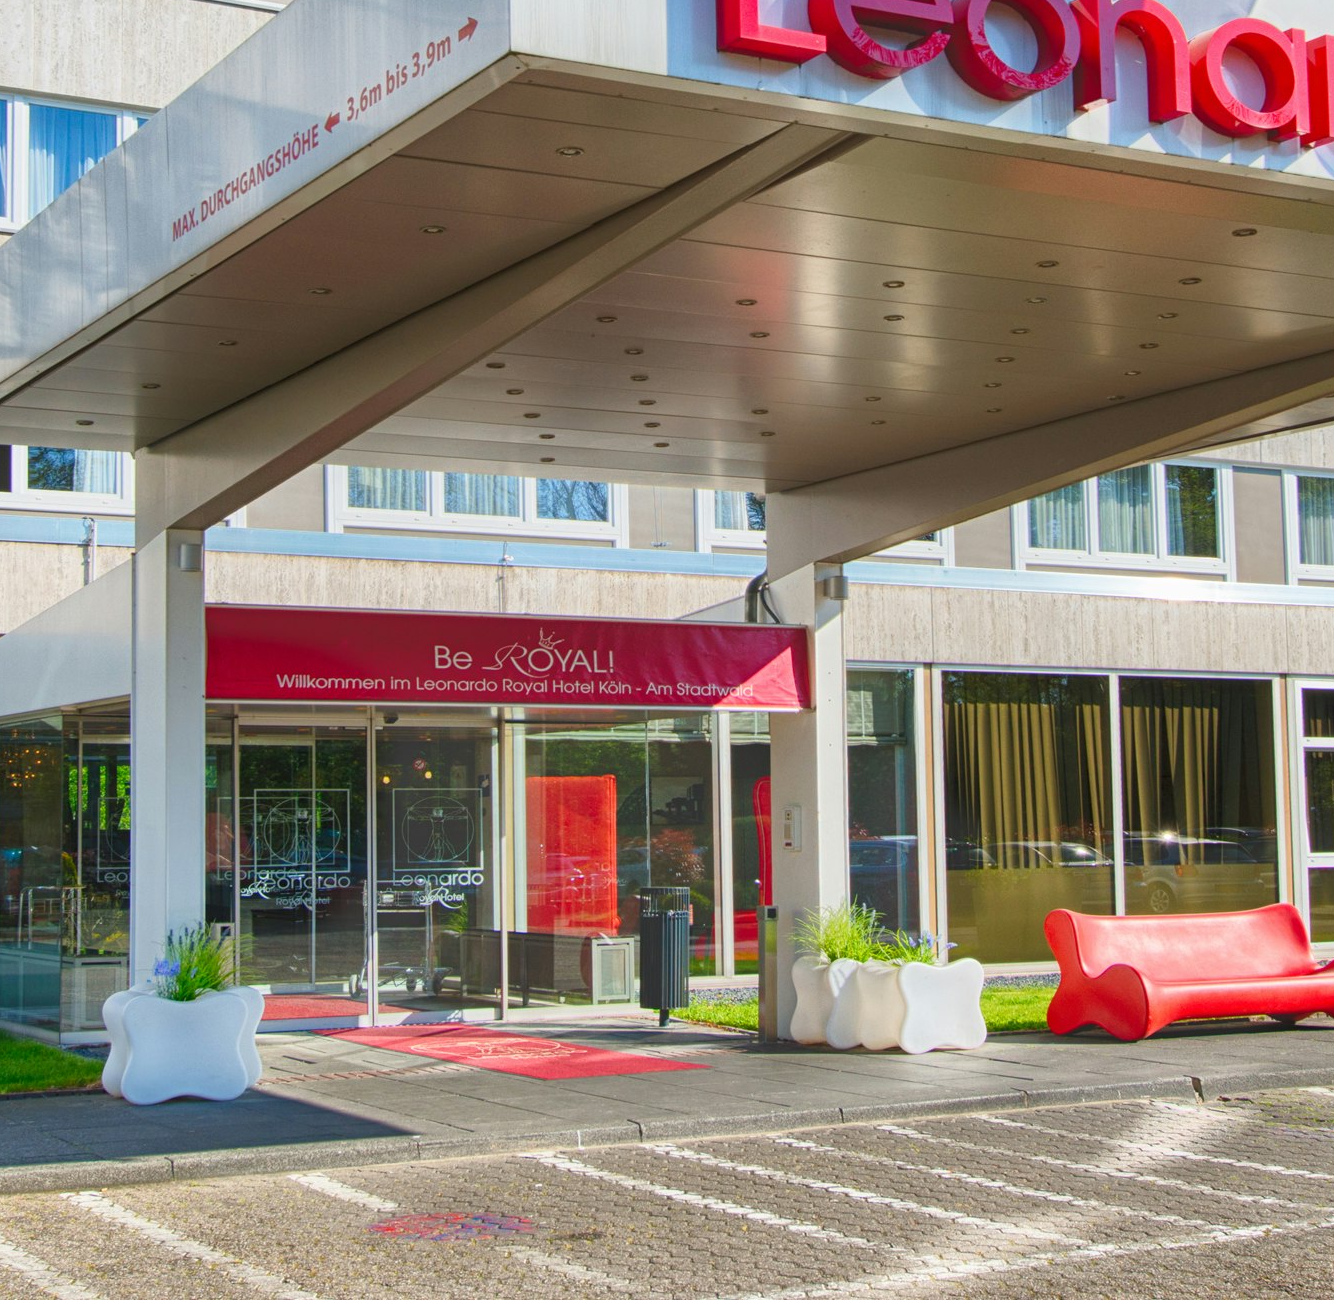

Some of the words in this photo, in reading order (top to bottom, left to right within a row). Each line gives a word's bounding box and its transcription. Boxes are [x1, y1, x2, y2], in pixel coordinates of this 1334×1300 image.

[172, 208, 199, 242] MAX.
[200, 123, 319, 222] DURCHGANGSHÖHE
[347, 83, 382, 122] 3,6m
[386, 63, 408, 96] bis
[411, 35, 451, 78] 3,9m
[433, 644, 473, 670] Be
[481, 641, 615, 679] ROYAL!
[275, 673, 386, 690] Willkommen
[390, 676, 411, 690] im
[416, 676, 499, 693] Leonardo
[502, 678, 548, 695] Royal
[552, 679, 595, 694] Hotel
[598, 680, 632, 695] Köln
[645, 681, 673, 696] Am
[676, 681, 754, 698] Stadtwald
[392, 870, 484, 887] Leonardo
